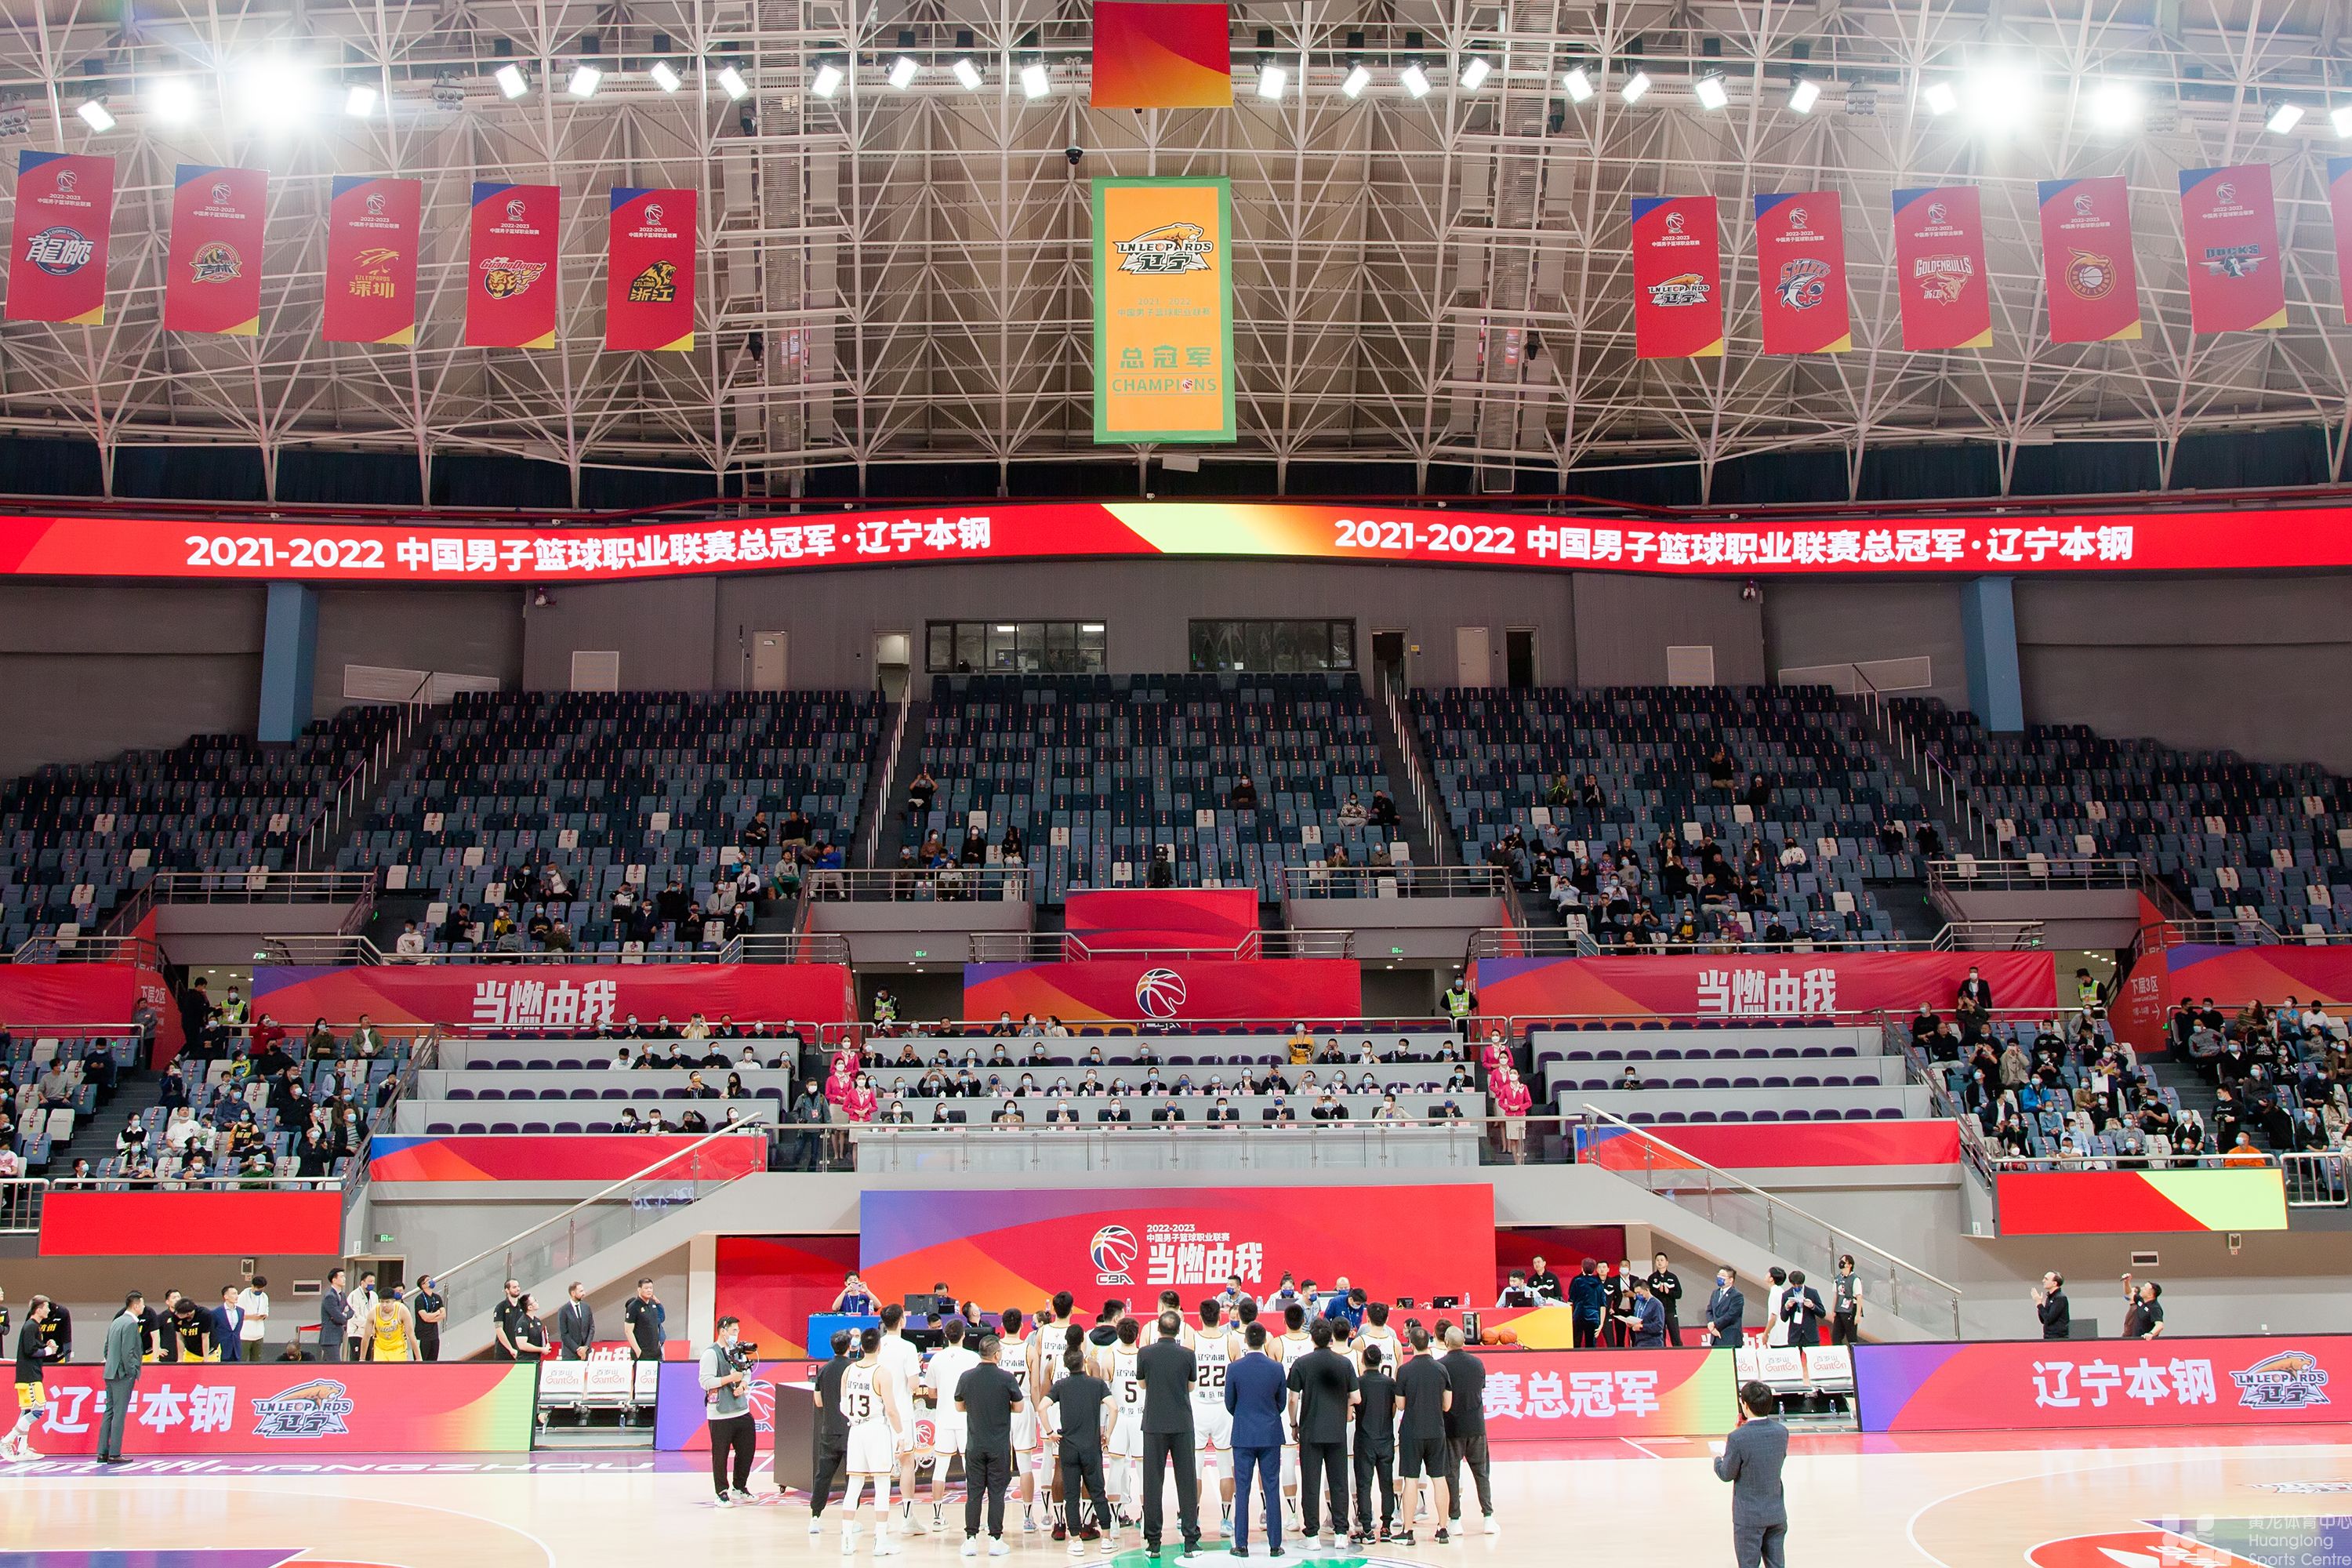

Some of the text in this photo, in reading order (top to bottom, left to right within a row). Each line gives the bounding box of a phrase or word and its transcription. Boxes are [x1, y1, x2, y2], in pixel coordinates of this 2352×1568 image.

[1118, 242, 1135, 252] LN
[1142, 252, 1192, 271] 辽宁
[349, 281, 395, 298] 深圳
[630, 288, 673, 301] 浙江
[1120, 345, 1211, 368] 总冠军
[1334, 519, 1515, 554] 2021-2022
[185, 535, 384, 568] 2021-2022
[1697, 968, 1836, 1018] 当燃由我
[471, 980, 616, 1030] 当燃由我
[1146, 1232, 1229, 1243] 中国男子篮球职业联赛
[1147, 1224, 1196, 1232] 2022-2023
[1147, 1242, 1263, 1285] 当燃由我
[1096, 1272, 1135, 1285] CBA
[1198, 1365, 1225, 1387] 22
[2032, 1358, 2216, 1408] 辽宁本钢
[2256, 1374, 2325, 1383] LEOPARDS
[1125, 1381, 1137, 1403] 5
[1482, 1370, 1660, 1419] 赛总冠军
[2259, 1385, 2306, 1403] 辽宁
[260, 1402, 350, 1411] LN LEOPARDS
[848, 1394, 870, 1417] 13
[278, 1412, 328, 1432] 辽宁
